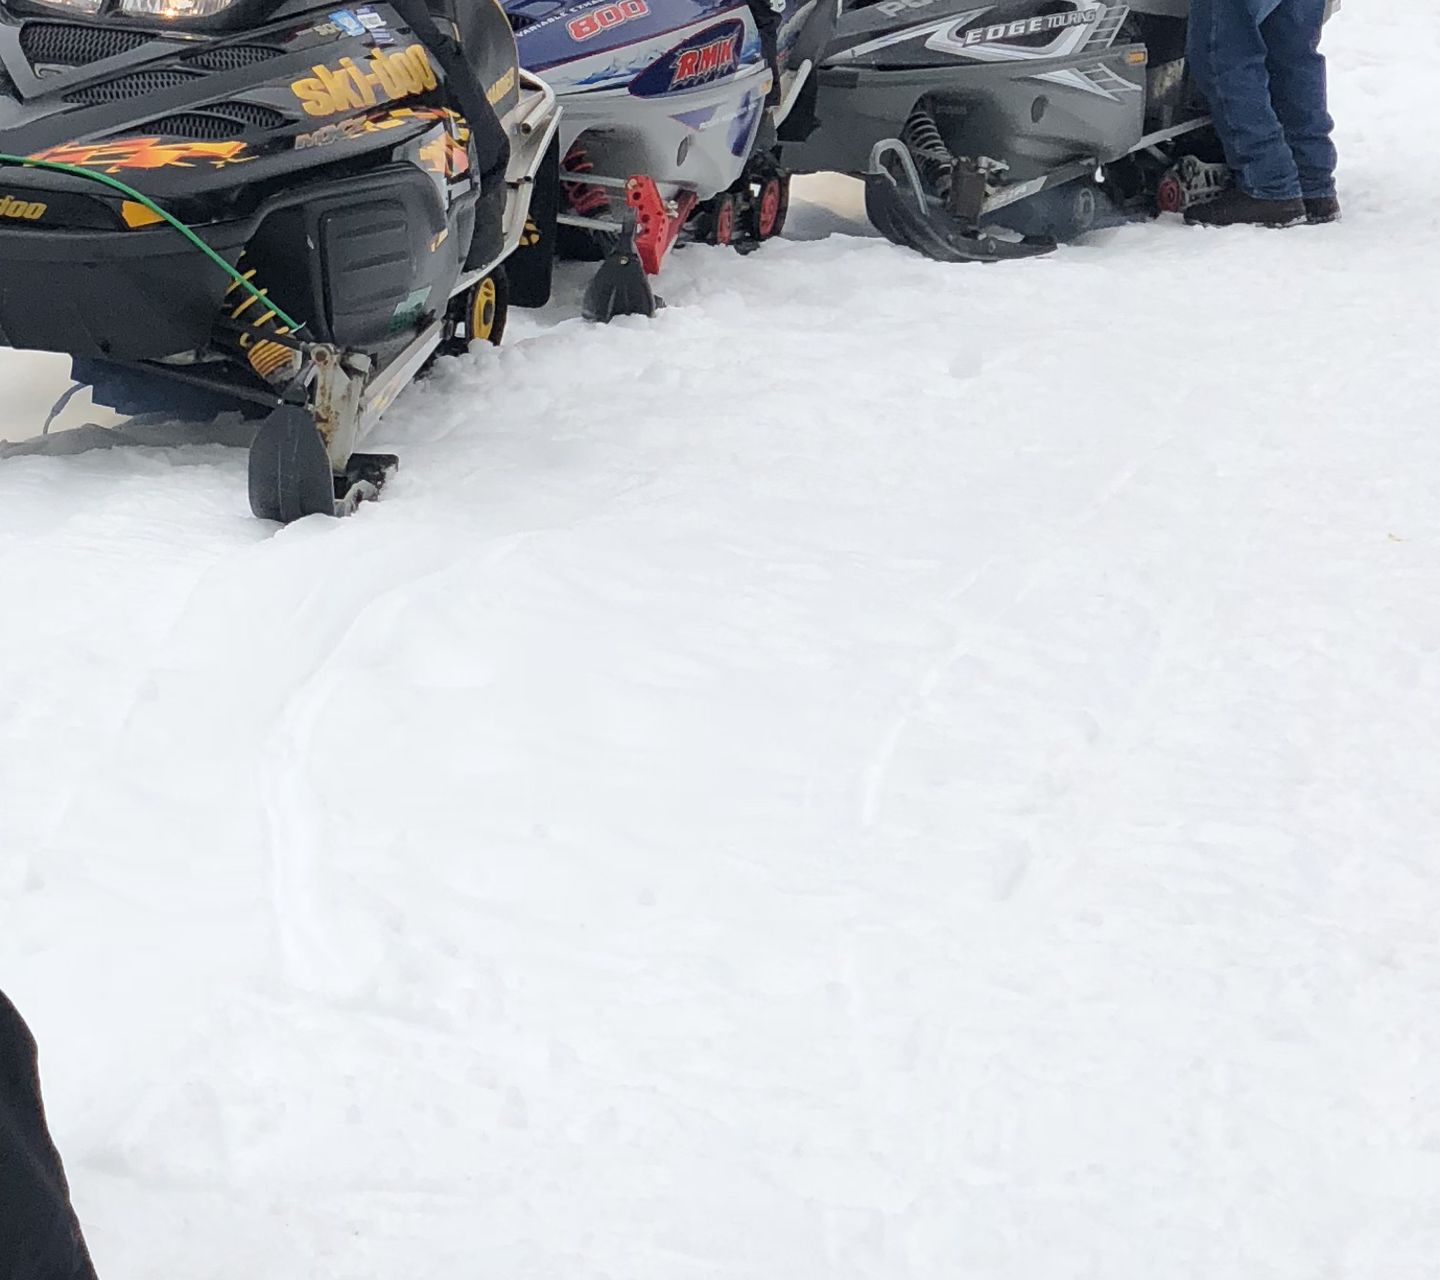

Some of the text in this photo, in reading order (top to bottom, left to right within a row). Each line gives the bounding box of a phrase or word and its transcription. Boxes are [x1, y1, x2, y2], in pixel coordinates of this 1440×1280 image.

[515, 11, 568, 37] VARIABLE
[964, 18, 1043, 46] EDGE
[672, 35, 738, 83] RMK
[291, 44, 438, 116] ski-doo
